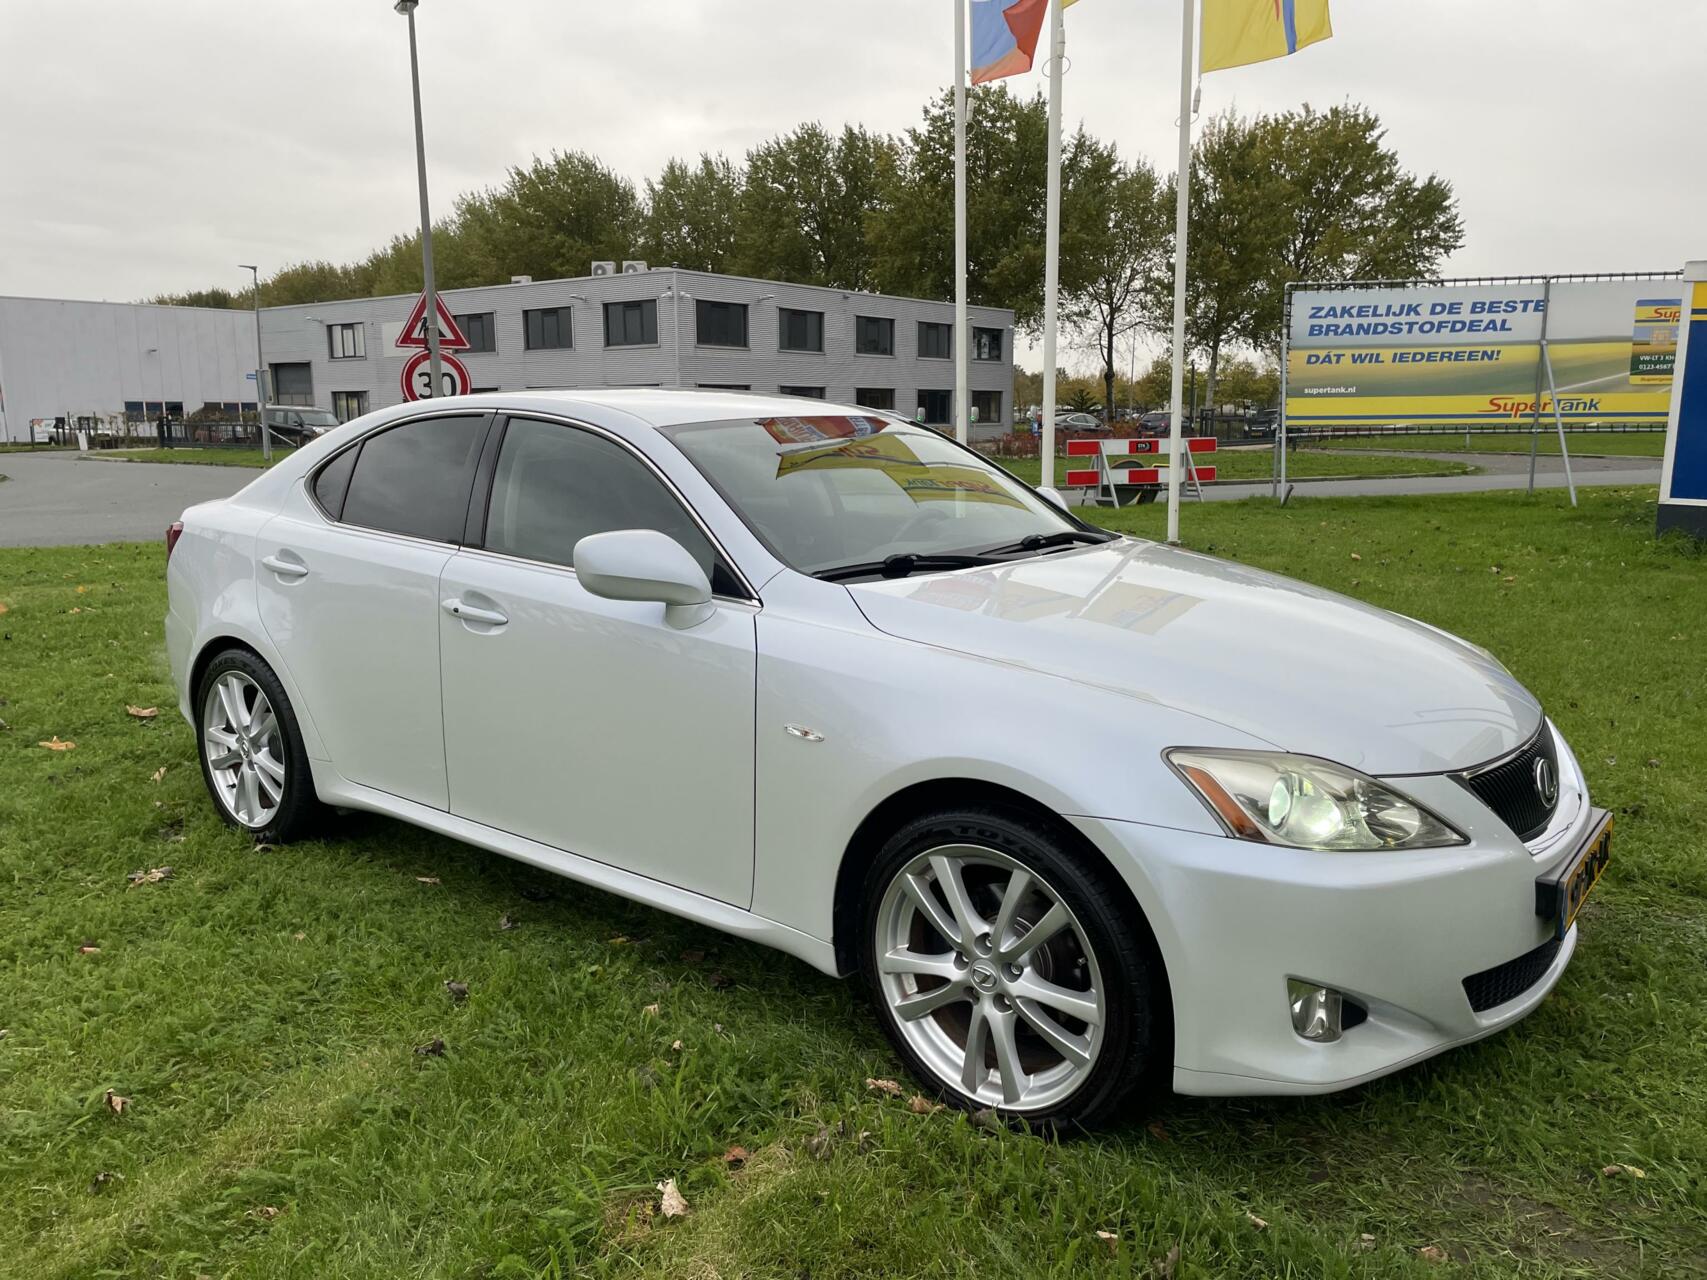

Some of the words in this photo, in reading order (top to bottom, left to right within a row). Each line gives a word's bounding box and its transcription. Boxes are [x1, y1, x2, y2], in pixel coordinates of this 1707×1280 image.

[1308, 304, 1422, 319] ZAKELIJK
[1429, 302, 1463, 316] DE
[1470, 300, 1546, 315] BESTE
[1308, 319, 1512, 337] BRANDSTOFDEAL
[1306, 351, 1345, 365] DÁT
[1351, 353, 1384, 364] WIL
[1392, 350, 1501, 363] IEDEREEN!
[417, 372, 457, 399] 30
[1304, 386, 1356, 395] supertank.nl
